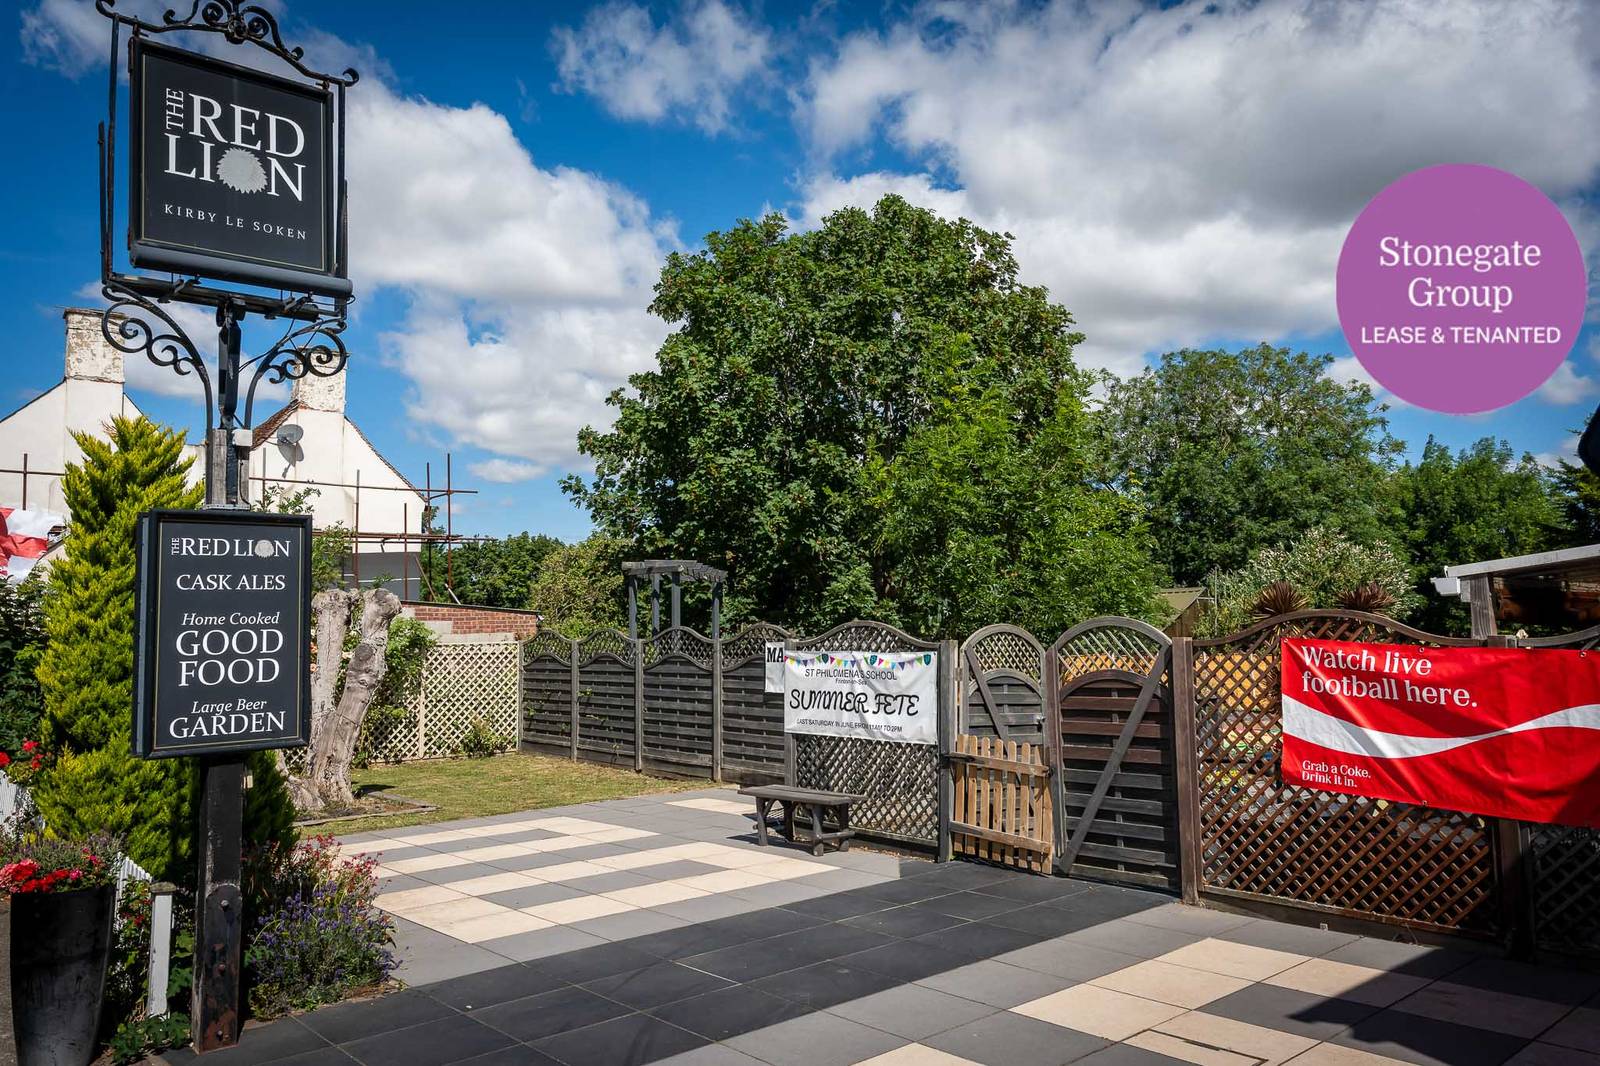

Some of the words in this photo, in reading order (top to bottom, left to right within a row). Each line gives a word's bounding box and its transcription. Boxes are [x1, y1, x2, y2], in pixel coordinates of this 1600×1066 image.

[166, 88, 184, 130] THE
[189, 93, 305, 158] RED
[164, 132, 306, 201] LION
[164, 204, 216, 222] KIRBY
[226, 216, 244, 228] LE
[253, 221, 306, 240] SOKEN
[171, 537, 180, 555] THE
[180, 537, 230, 557] RED
[234, 539, 291, 558] LION
[176, 574, 232, 591] CASK
[236, 574, 286, 590] ALES
[182, 613, 226, 626] Home
[229, 612, 280, 625] Cooked
[175, 628, 284, 657] GOOD
[178, 658, 280, 687] FOOD
[804, 668, 814, 677] ST
[866, 670, 897, 681] SCHOOL
[1301, 646, 1376, 673] Watch
[1384, 652, 1432, 676] live
[789, 688, 869, 714] SUMMER
[872, 693, 920, 717] FETE
[1302, 671, 1399, 701] football
[1405, 680, 1478, 708] here.
[191, 700, 232, 716] Large
[236, 699, 267, 711] Beer
[169, 711, 286, 738] GARDEN
[1302, 760, 1329, 773] Grab
[1331, 765, 1338, 774] a
[1340, 764, 1371, 779] Coke.
[1302, 770, 1331, 784] Drink
[1334, 774, 1342, 785] it
[1344, 776, 1358, 788] in.
